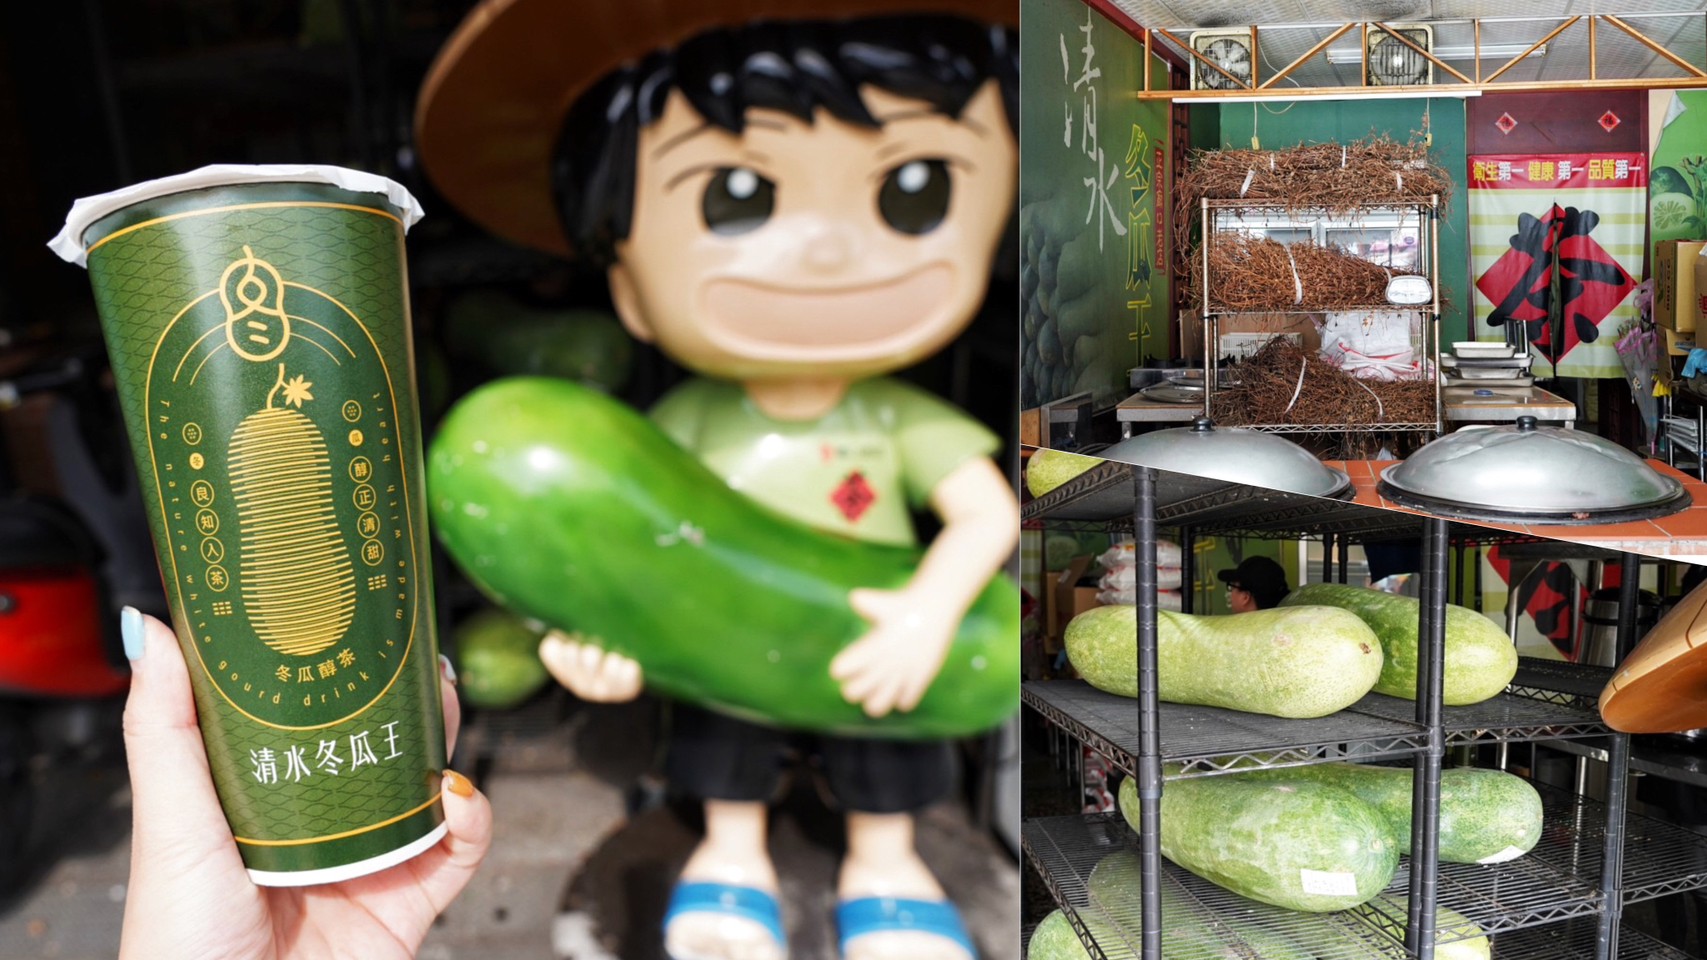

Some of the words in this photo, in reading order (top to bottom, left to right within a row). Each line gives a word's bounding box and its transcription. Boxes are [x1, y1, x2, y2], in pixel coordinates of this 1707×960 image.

[1060, 6, 1127, 254] 清水
[1473, 161, 1524, 181] 衛生第一
[1588, 159, 1641, 180] 品質第一
[1486, 206, 1625, 356] 茶
[160, 400, 170, 440] The
[373, 392, 391, 462] heart
[166, 464, 187, 551] nature
[194, 484, 226, 587] 良知入茶
[352, 460, 382, 562] 醇正清甜
[387, 485, 401, 538] with
[186, 575, 211, 643] white
[395, 560, 406, 619] made
[275, 648, 355, 683] 冬瓜醇茶
[379, 639, 394, 659] is
[219, 659, 281, 704] gourd
[303, 671, 369, 706] drink
[250, 721, 402, 784] 清水冬瓜王
